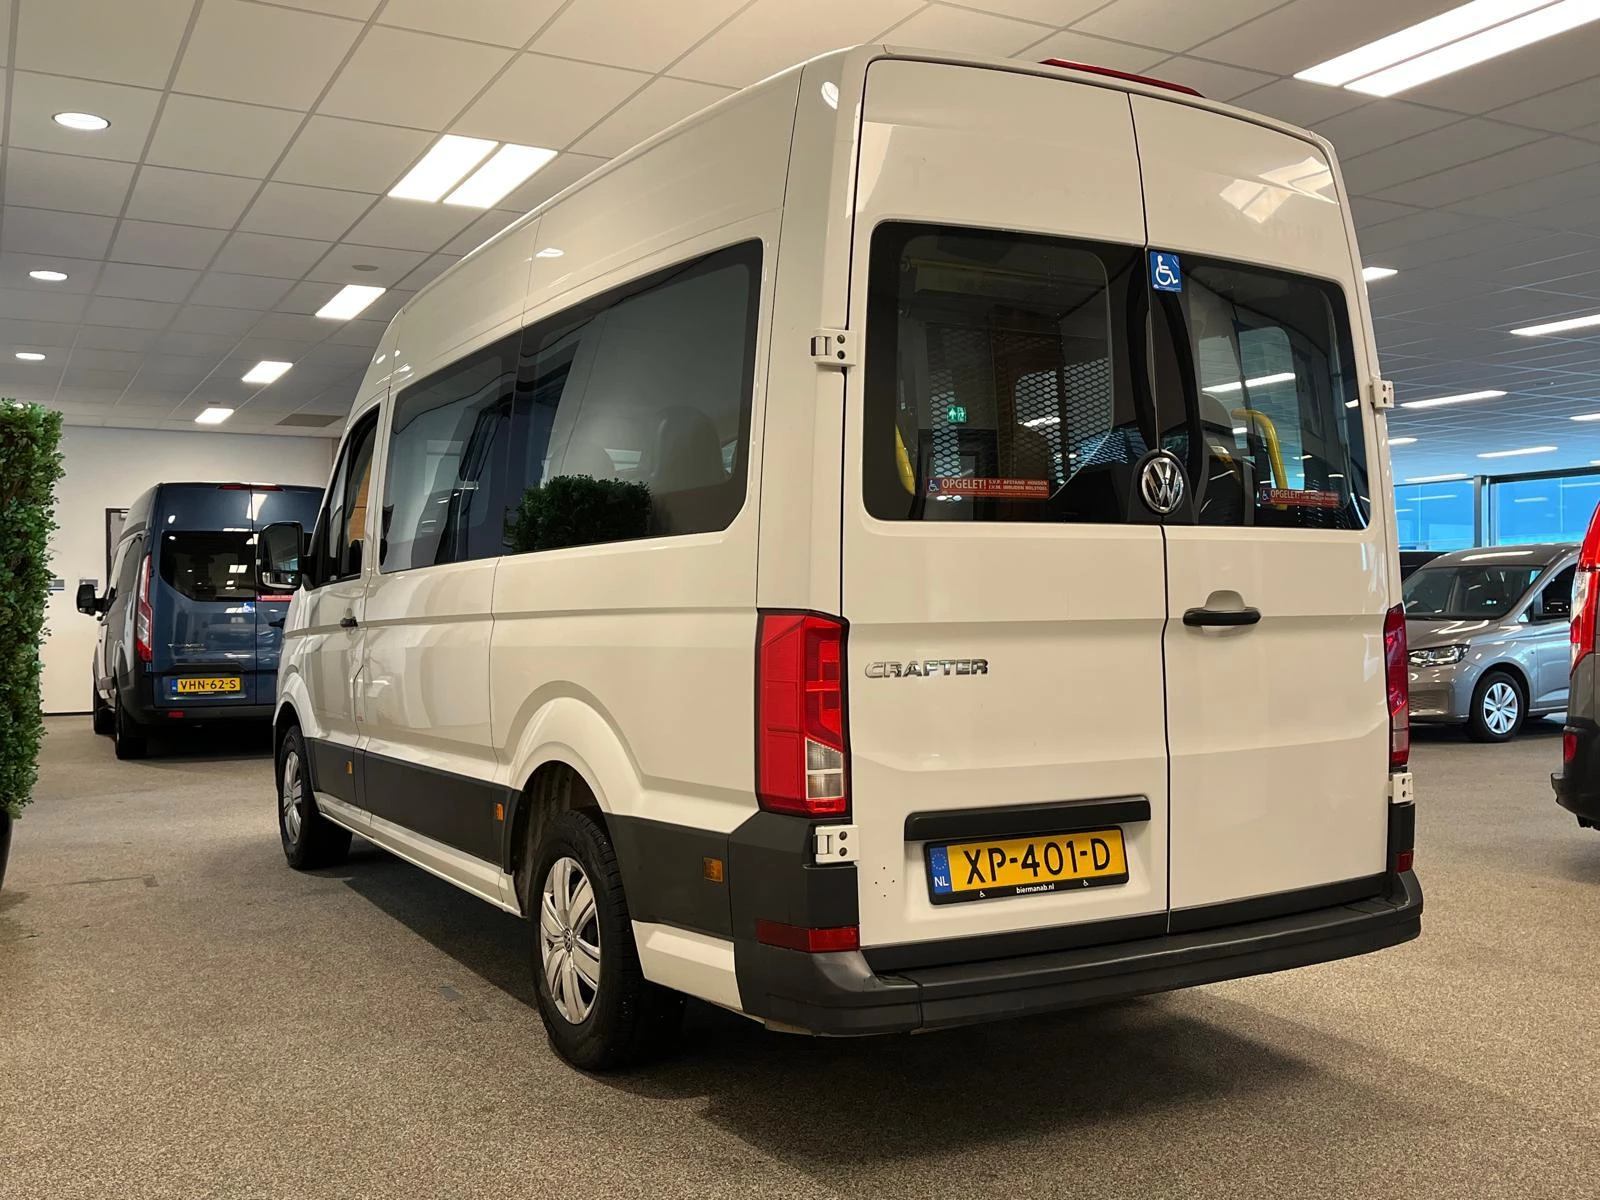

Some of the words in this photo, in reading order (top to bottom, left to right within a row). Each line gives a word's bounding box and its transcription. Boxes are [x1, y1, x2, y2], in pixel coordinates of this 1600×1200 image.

[941, 478, 987, 490] OPGELET!
[864, 658, 989, 679] CRAFTER
[180, 680, 237, 690] VHN-62-S
[963, 837, 1111, 885] XP-401-D
[934, 876, 950, 888] NL
[1016, 883, 1055, 894] biermanab.nl
